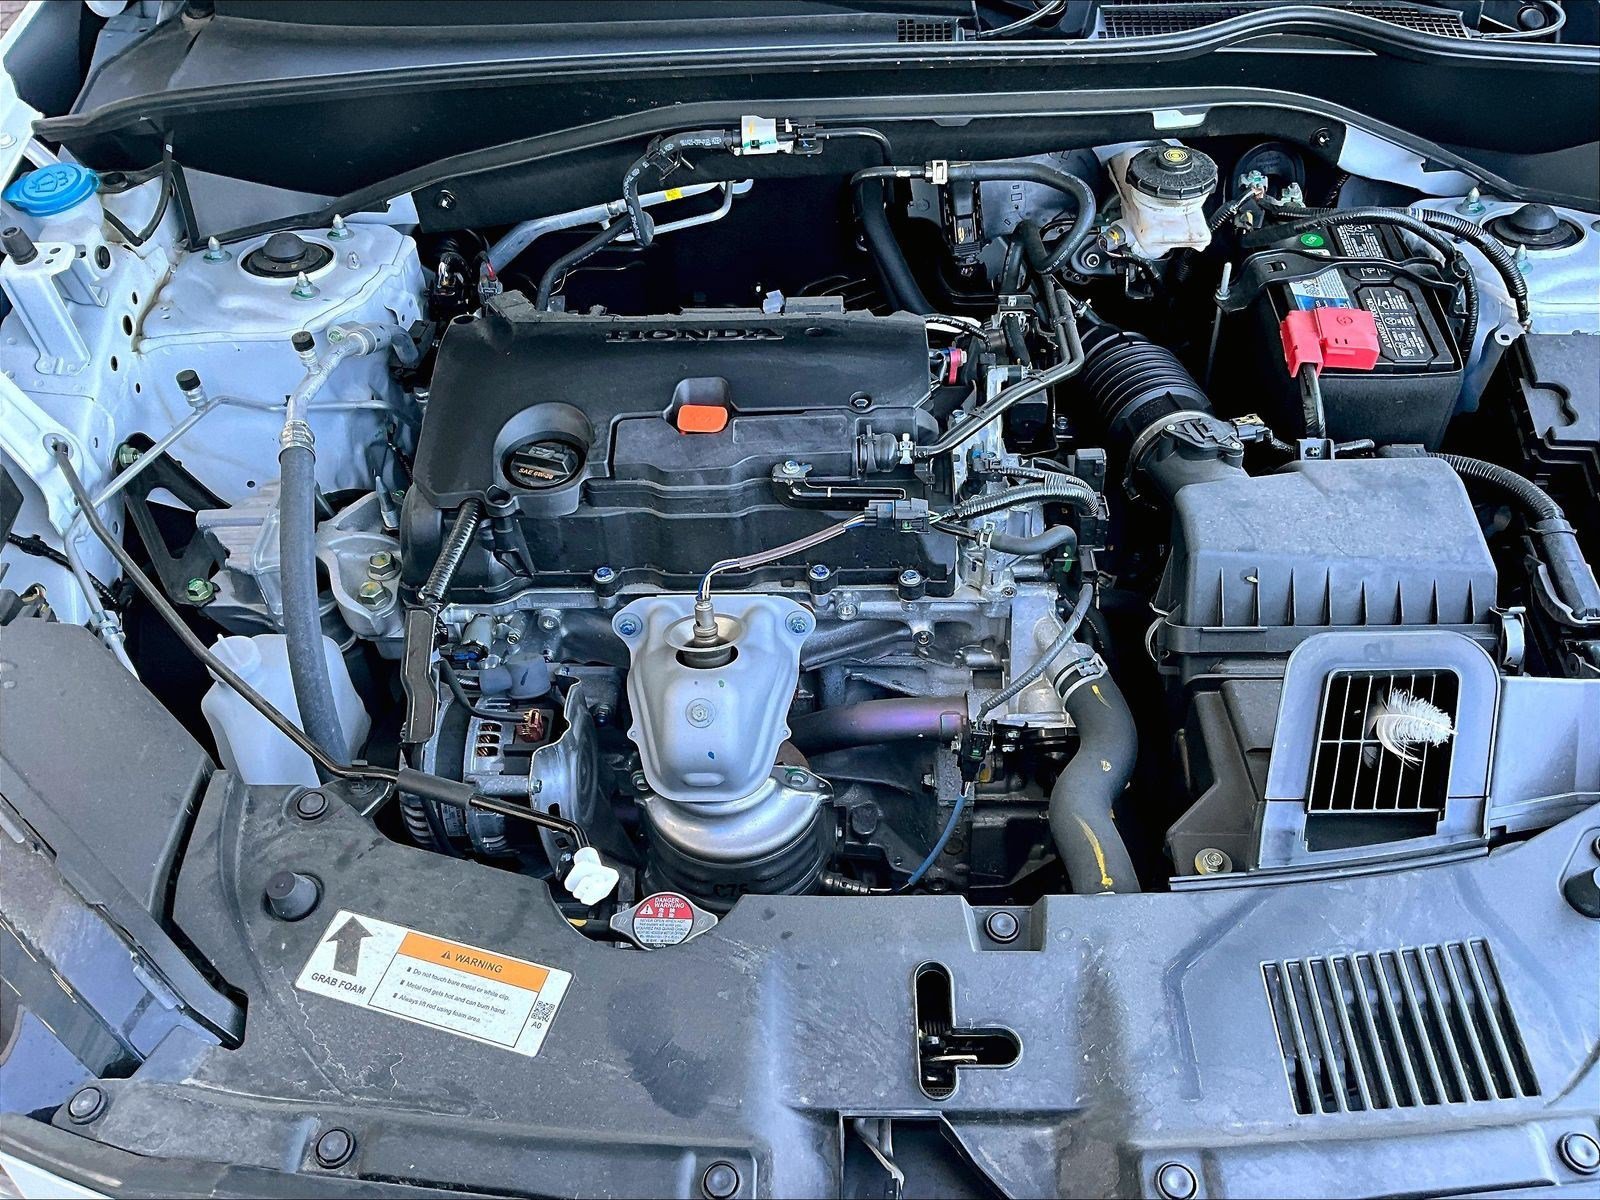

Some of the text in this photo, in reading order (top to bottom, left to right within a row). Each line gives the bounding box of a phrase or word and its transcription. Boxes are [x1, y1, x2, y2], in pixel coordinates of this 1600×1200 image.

[605, 329, 785, 343] HONDA
[518, 467, 534, 476] SAE
[455, 953, 503, 974] WARNING
[311, 972, 367, 995] GRAB FOAM
[406, 981, 421, 990] Metal
[421, 985, 432, 993] rod
[444, 992, 454, 1000] hot
[412, 968, 422, 976] Do
[432, 974, 447, 983] touch
[447, 978, 460, 986] bare
[460, 982, 476, 991] metal
[484, 989, 498, 998] white
[499, 993, 510, 1001] clip.
[398, 994, 418, 1005] Always
[427, 1002, 437, 1010] rod
[436, 1005, 452, 1015] using
[452, 1010, 467, 1018] foam
